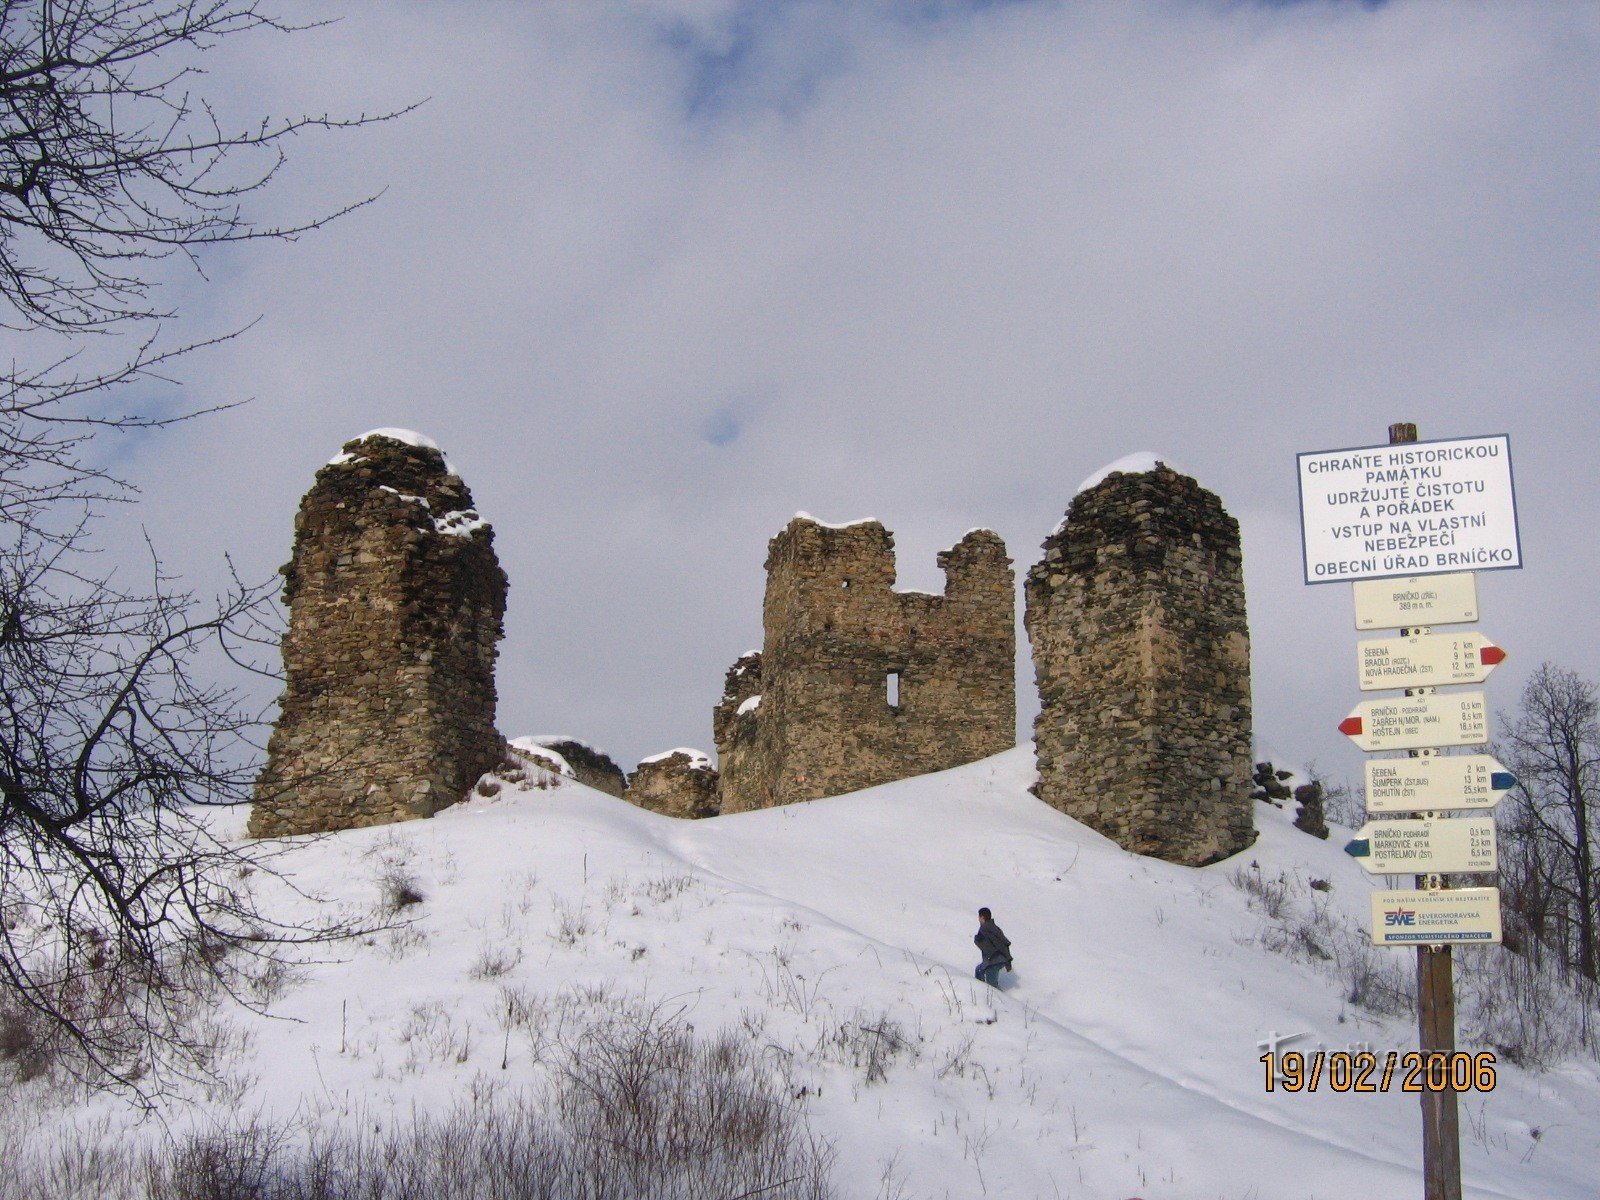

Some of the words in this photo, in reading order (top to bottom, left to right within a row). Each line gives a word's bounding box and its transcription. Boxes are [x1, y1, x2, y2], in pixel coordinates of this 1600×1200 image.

[1308, 454, 1382, 474] CHRAŇTE
[1389, 444, 1498, 466] HISTORICKOU
[1366, 466, 1442, 484] PAMÁTKU
[1327, 486, 1410, 506] UDRŽUJTE
[1416, 480, 1485, 496] ČISTOTU
[1360, 507, 1370, 518] A
[1376, 498, 1454, 516] POŘÁDEK
[1332, 524, 1382, 539] VSTUP
[1390, 521, 1412, 534] NA
[1418, 512, 1486, 532] VLASTNÍ
[1365, 531, 1455, 552] NEBEZPEČÍ
[1315, 557, 1376, 576] OBECNÍ
[1384, 554, 1429, 570] ÚŘAD
[1436, 547, 1512, 566] BRNÍČKO
[1392, 591, 1420, 602] BRNÍČKO
[1400, 602, 1411, 610] 389
[1364, 646, 1389, 657] ŠEBENÁ
[1364, 658, 1390, 667] BRADLO
[1366, 666, 1382, 677] NOVÁ
[1383, 665, 1417, 676] HRADEČNÁ
[1452, 662, 1459, 670] 12
[1371, 705, 1398, 716] BRNÍČKO
[1402, 706, 1428, 714] PODHRADÍ
[1461, 702, 1471, 710] 0,5
[1472, 712, 1482, 720] km
[1372, 726, 1400, 737] HOŠTEJN
[1473, 722, 1483, 730] km
[1372, 767, 1397, 777] ŠEBENÁ
[1372, 777, 1402, 787] ŠUMPERK
[1477, 775, 1486, 783] km
[1373, 787, 1400, 798] BOHUTÍN
[1478, 785, 1487, 794] km
[1374, 828, 1402, 838] BRNÍČKO
[1403, 830, 1429, 838] PODHRADÍ
[1470, 828, 1479, 836] 0,5
[1374, 840, 1411, 849] MARKOVICE
[1471, 838, 1480, 846] 2,5
[1480, 838, 1490, 846] km
[1375, 849, 1417, 860] POSTŘELMOV
[1471, 849, 1481, 857] 6,5
[1384, 910, 1416, 926] SME
